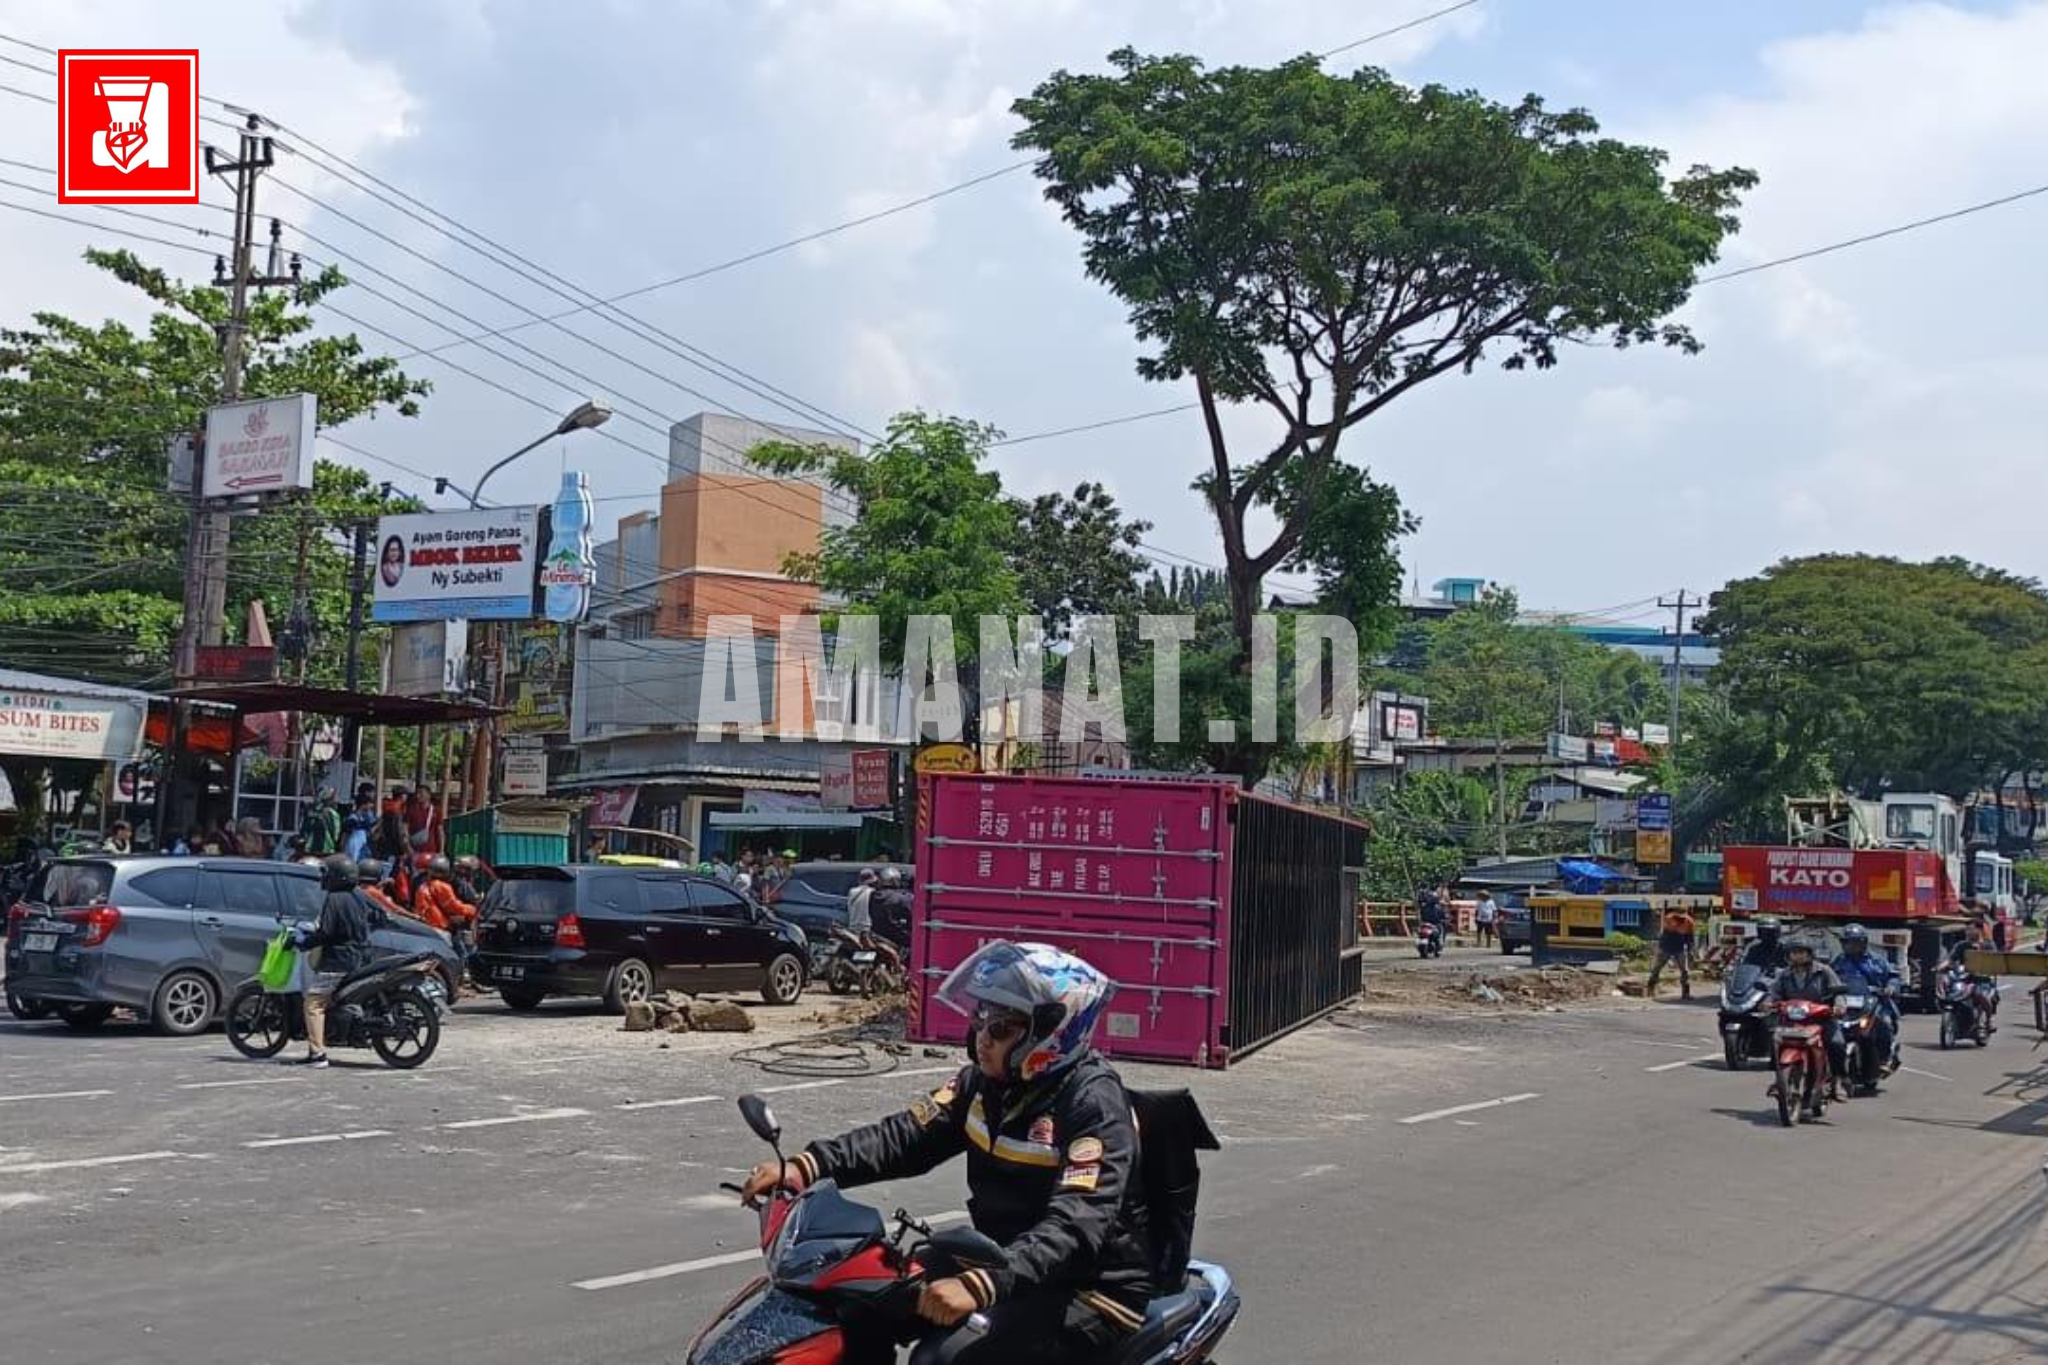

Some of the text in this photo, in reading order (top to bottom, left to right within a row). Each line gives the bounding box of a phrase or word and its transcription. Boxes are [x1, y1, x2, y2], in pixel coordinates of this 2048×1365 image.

[413, 527, 522, 544] Ayam Goreng Panas
[432, 567, 503, 588] Ny Subekti
[50, 714, 101, 733] BITES
[1770, 868, 1850, 888] KATO
